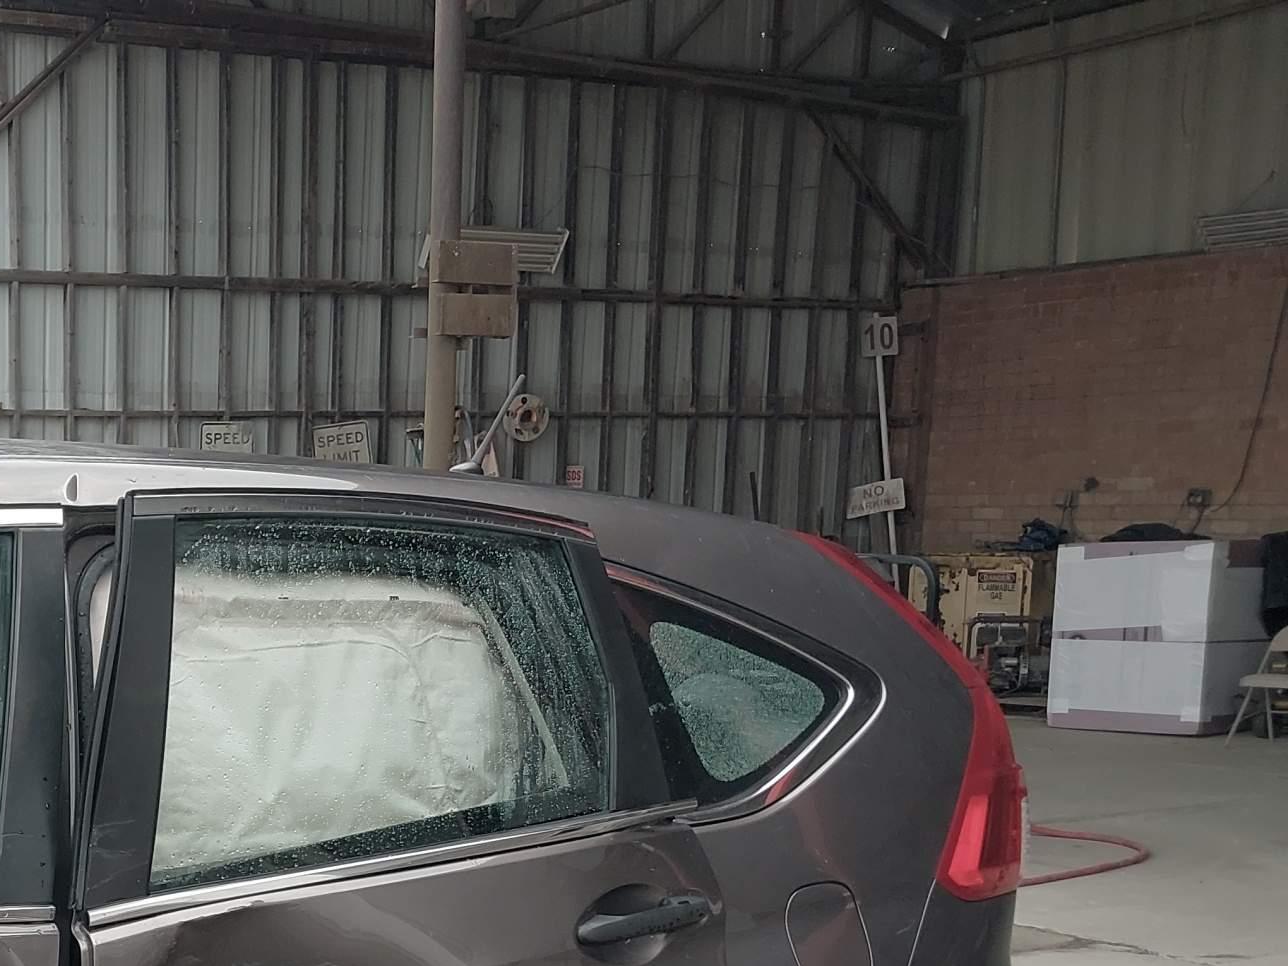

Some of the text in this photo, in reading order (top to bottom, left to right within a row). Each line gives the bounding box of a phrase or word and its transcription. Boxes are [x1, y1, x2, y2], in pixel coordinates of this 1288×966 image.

[863, 322, 894, 351] 10
[205, 432, 250, 445] SPEED
[317, 431, 364, 448] SPEED
[567, 470, 581, 481] SDS
[863, 485, 885, 499] NO
[851, 496, 900, 512] PARKING
[978, 583, 1016, 592] FLAMMABLE
[991, 592, 1003, 600] GAS
